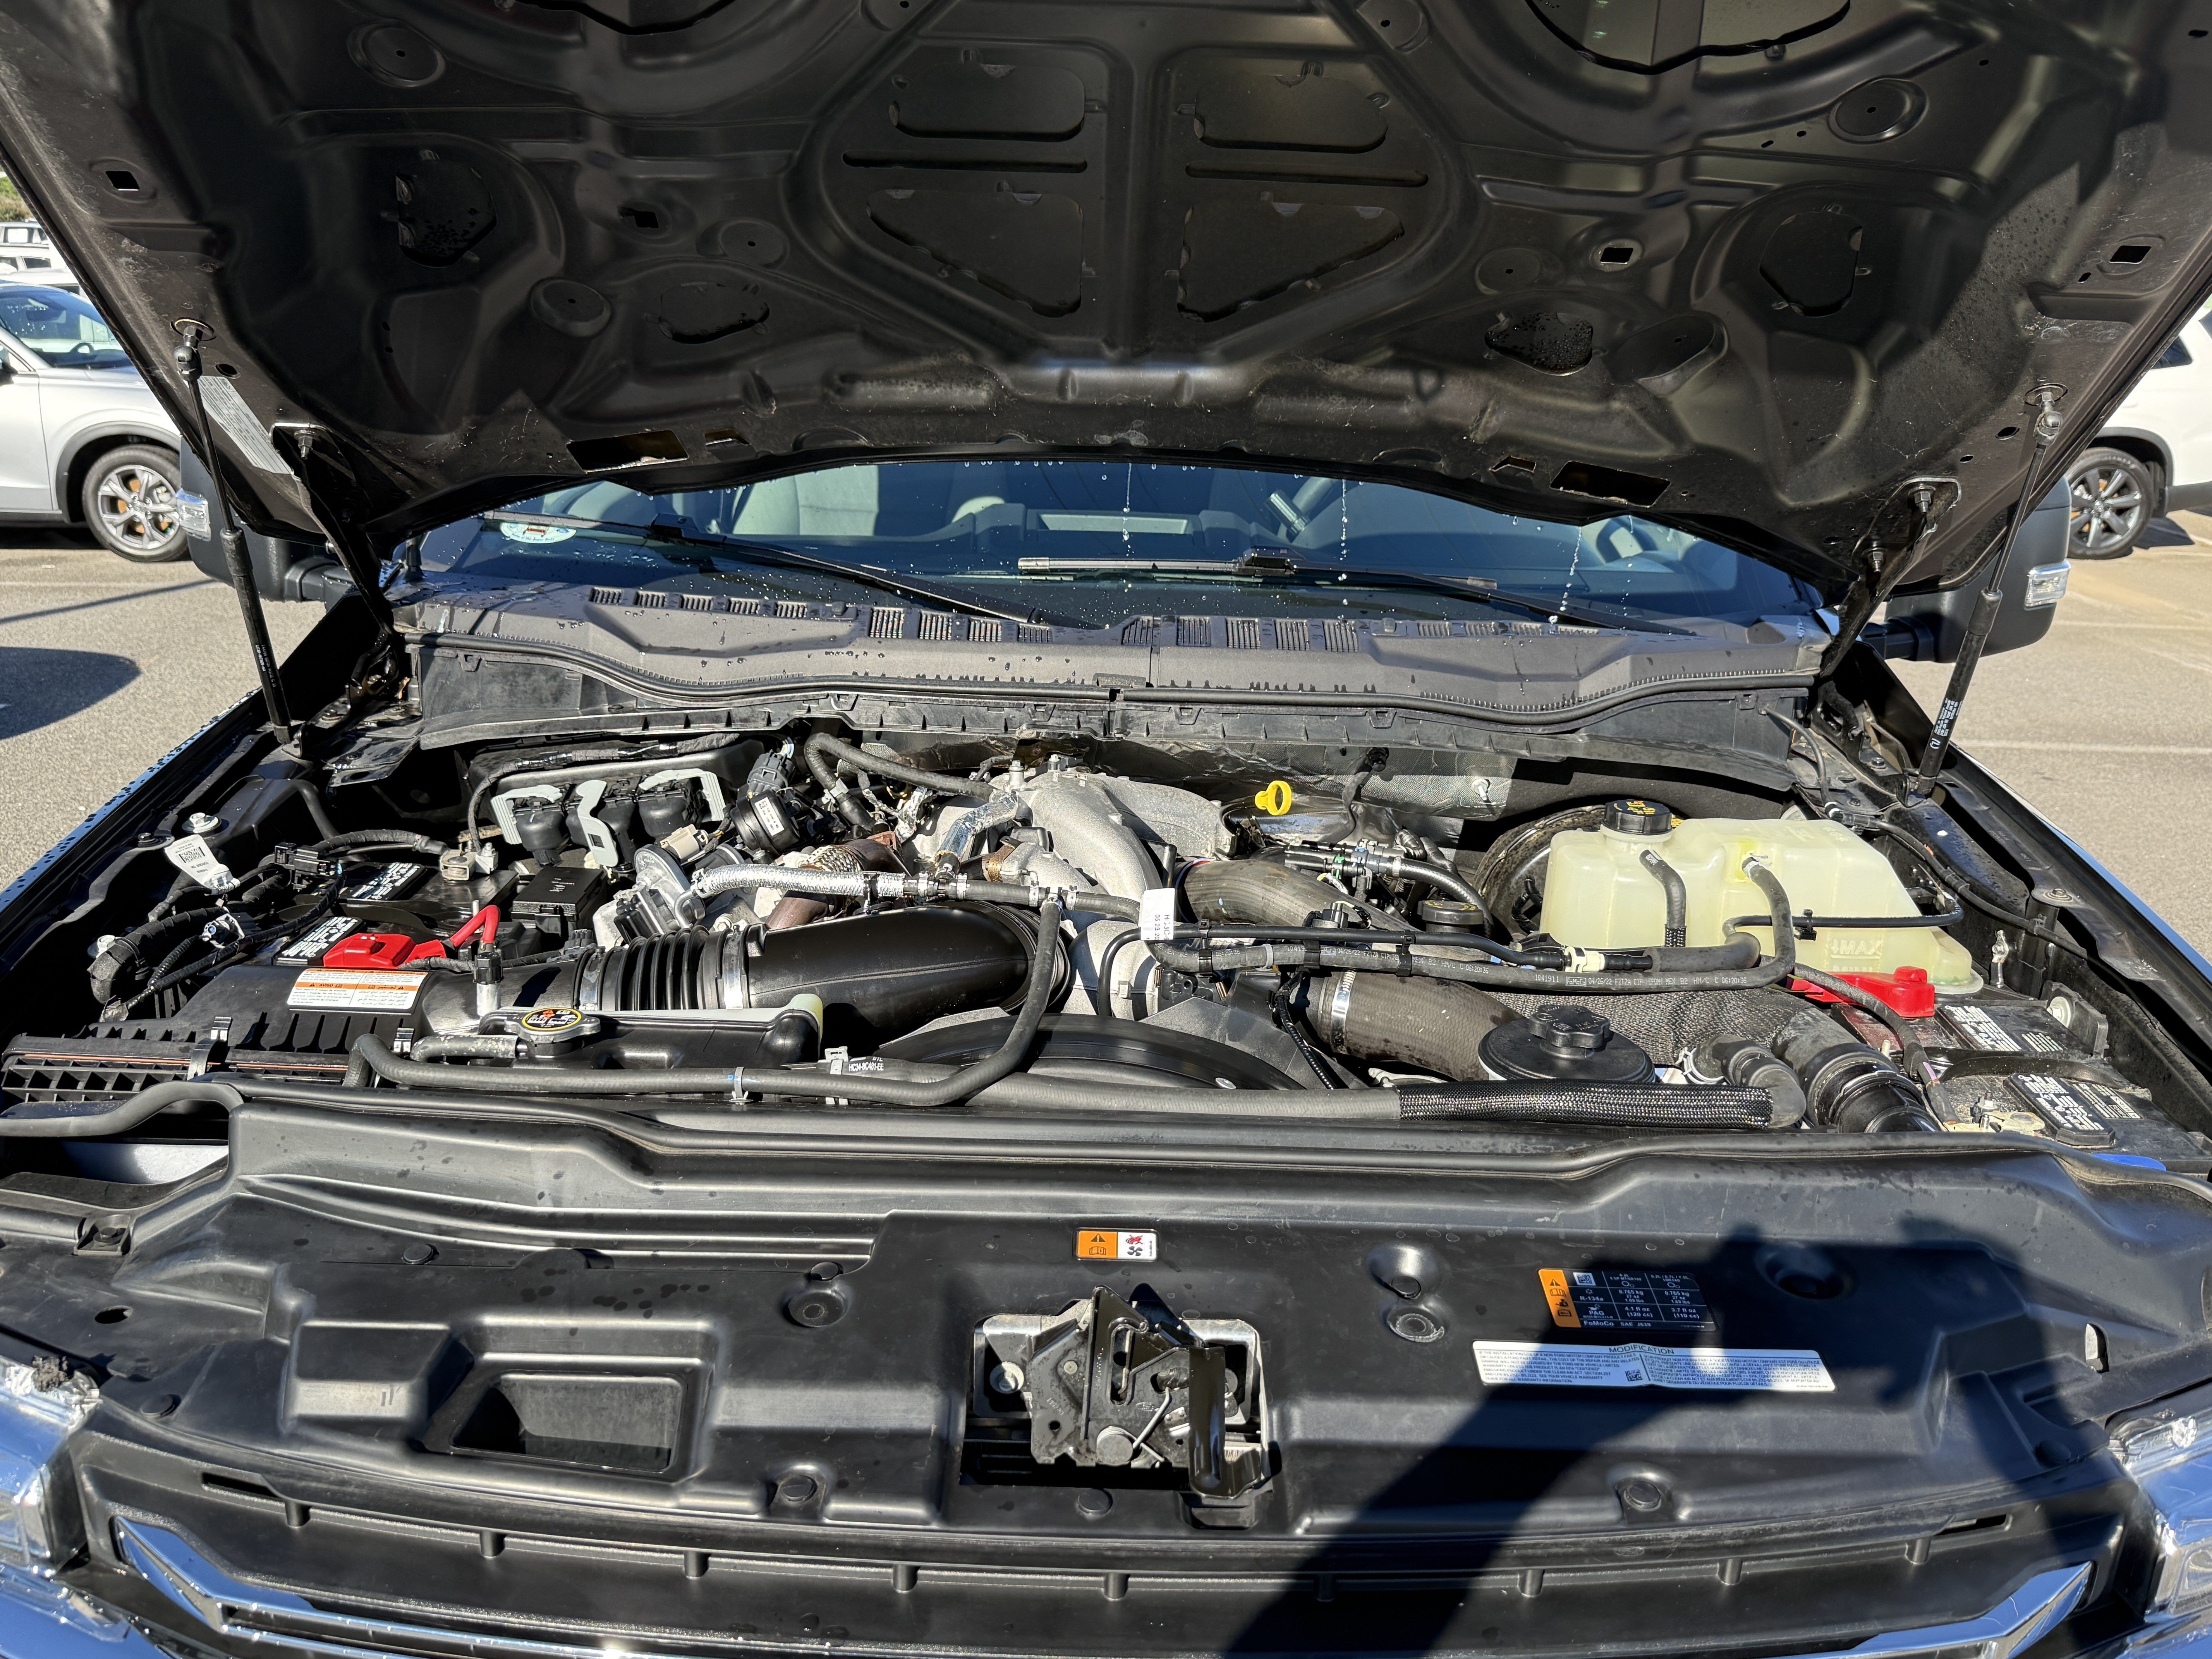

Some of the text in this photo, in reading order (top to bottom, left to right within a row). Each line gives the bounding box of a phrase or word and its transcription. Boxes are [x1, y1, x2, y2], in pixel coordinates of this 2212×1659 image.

[1840, 939, 1882, 955] MAX
[1535, 974, 1559, 982] 1041911
[1609, 1344, 1674, 1355] MODIFICATION
